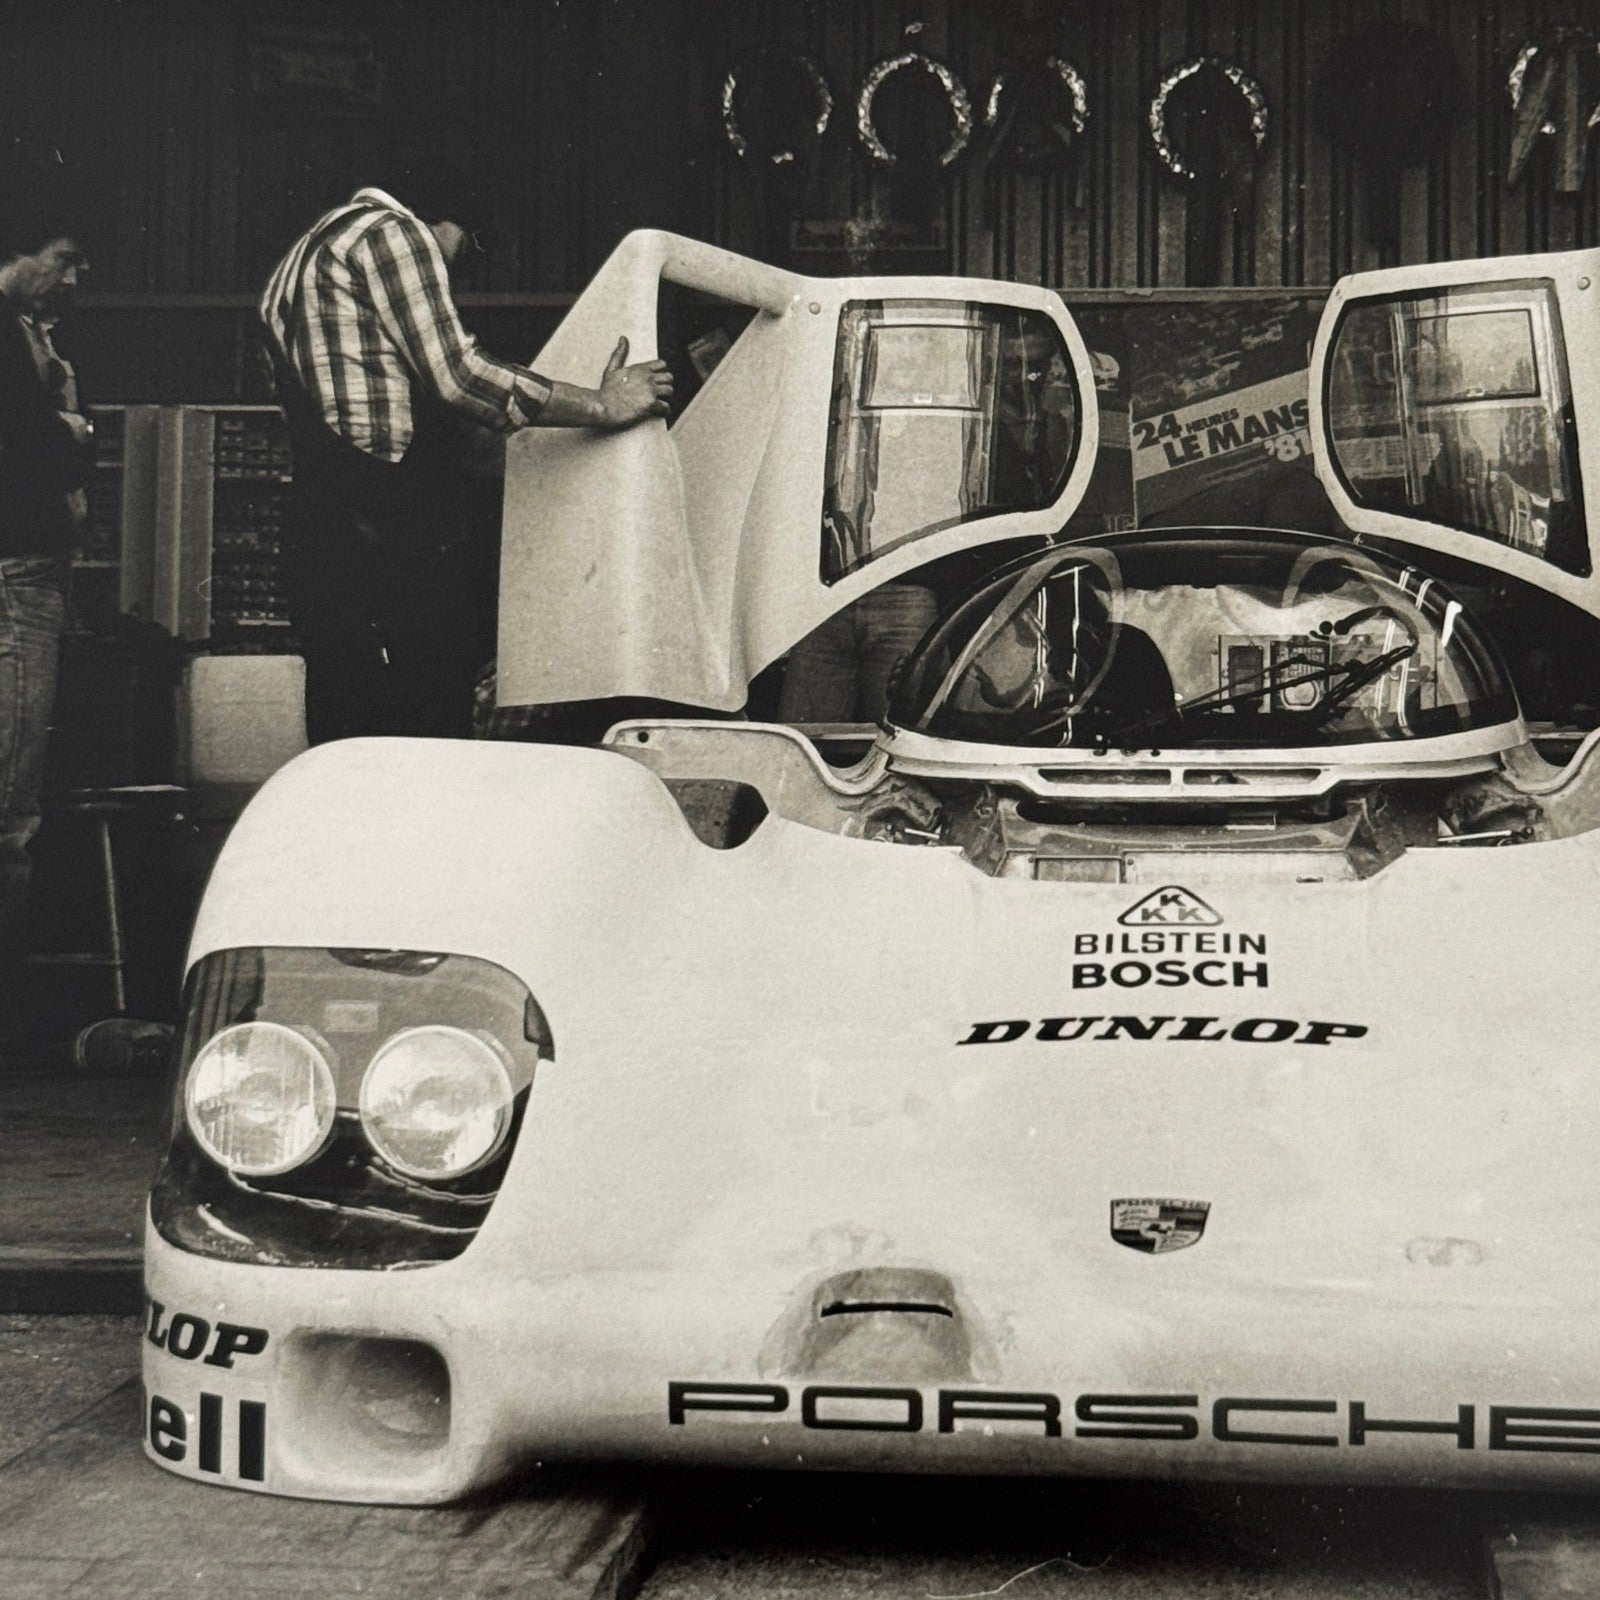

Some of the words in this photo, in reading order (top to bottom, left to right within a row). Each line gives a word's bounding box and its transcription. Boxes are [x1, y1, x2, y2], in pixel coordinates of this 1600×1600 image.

[1133, 414, 1183, 450] 24
[1186, 409, 1239, 433] HEURES
[1163, 435, 1204, 468] LE
[1207, 399, 1309, 453] MANS
[1075, 932, 1266, 954] BILSTEIN
[1072, 960, 1269, 989] BOSCH
[957, 1017, 1368, 1044] DUNLOP
[149, 1301, 269, 1369] LOP
[151, 1393, 266, 1481] ell
[668, 1382, 1600, 1454] PORSCHE
